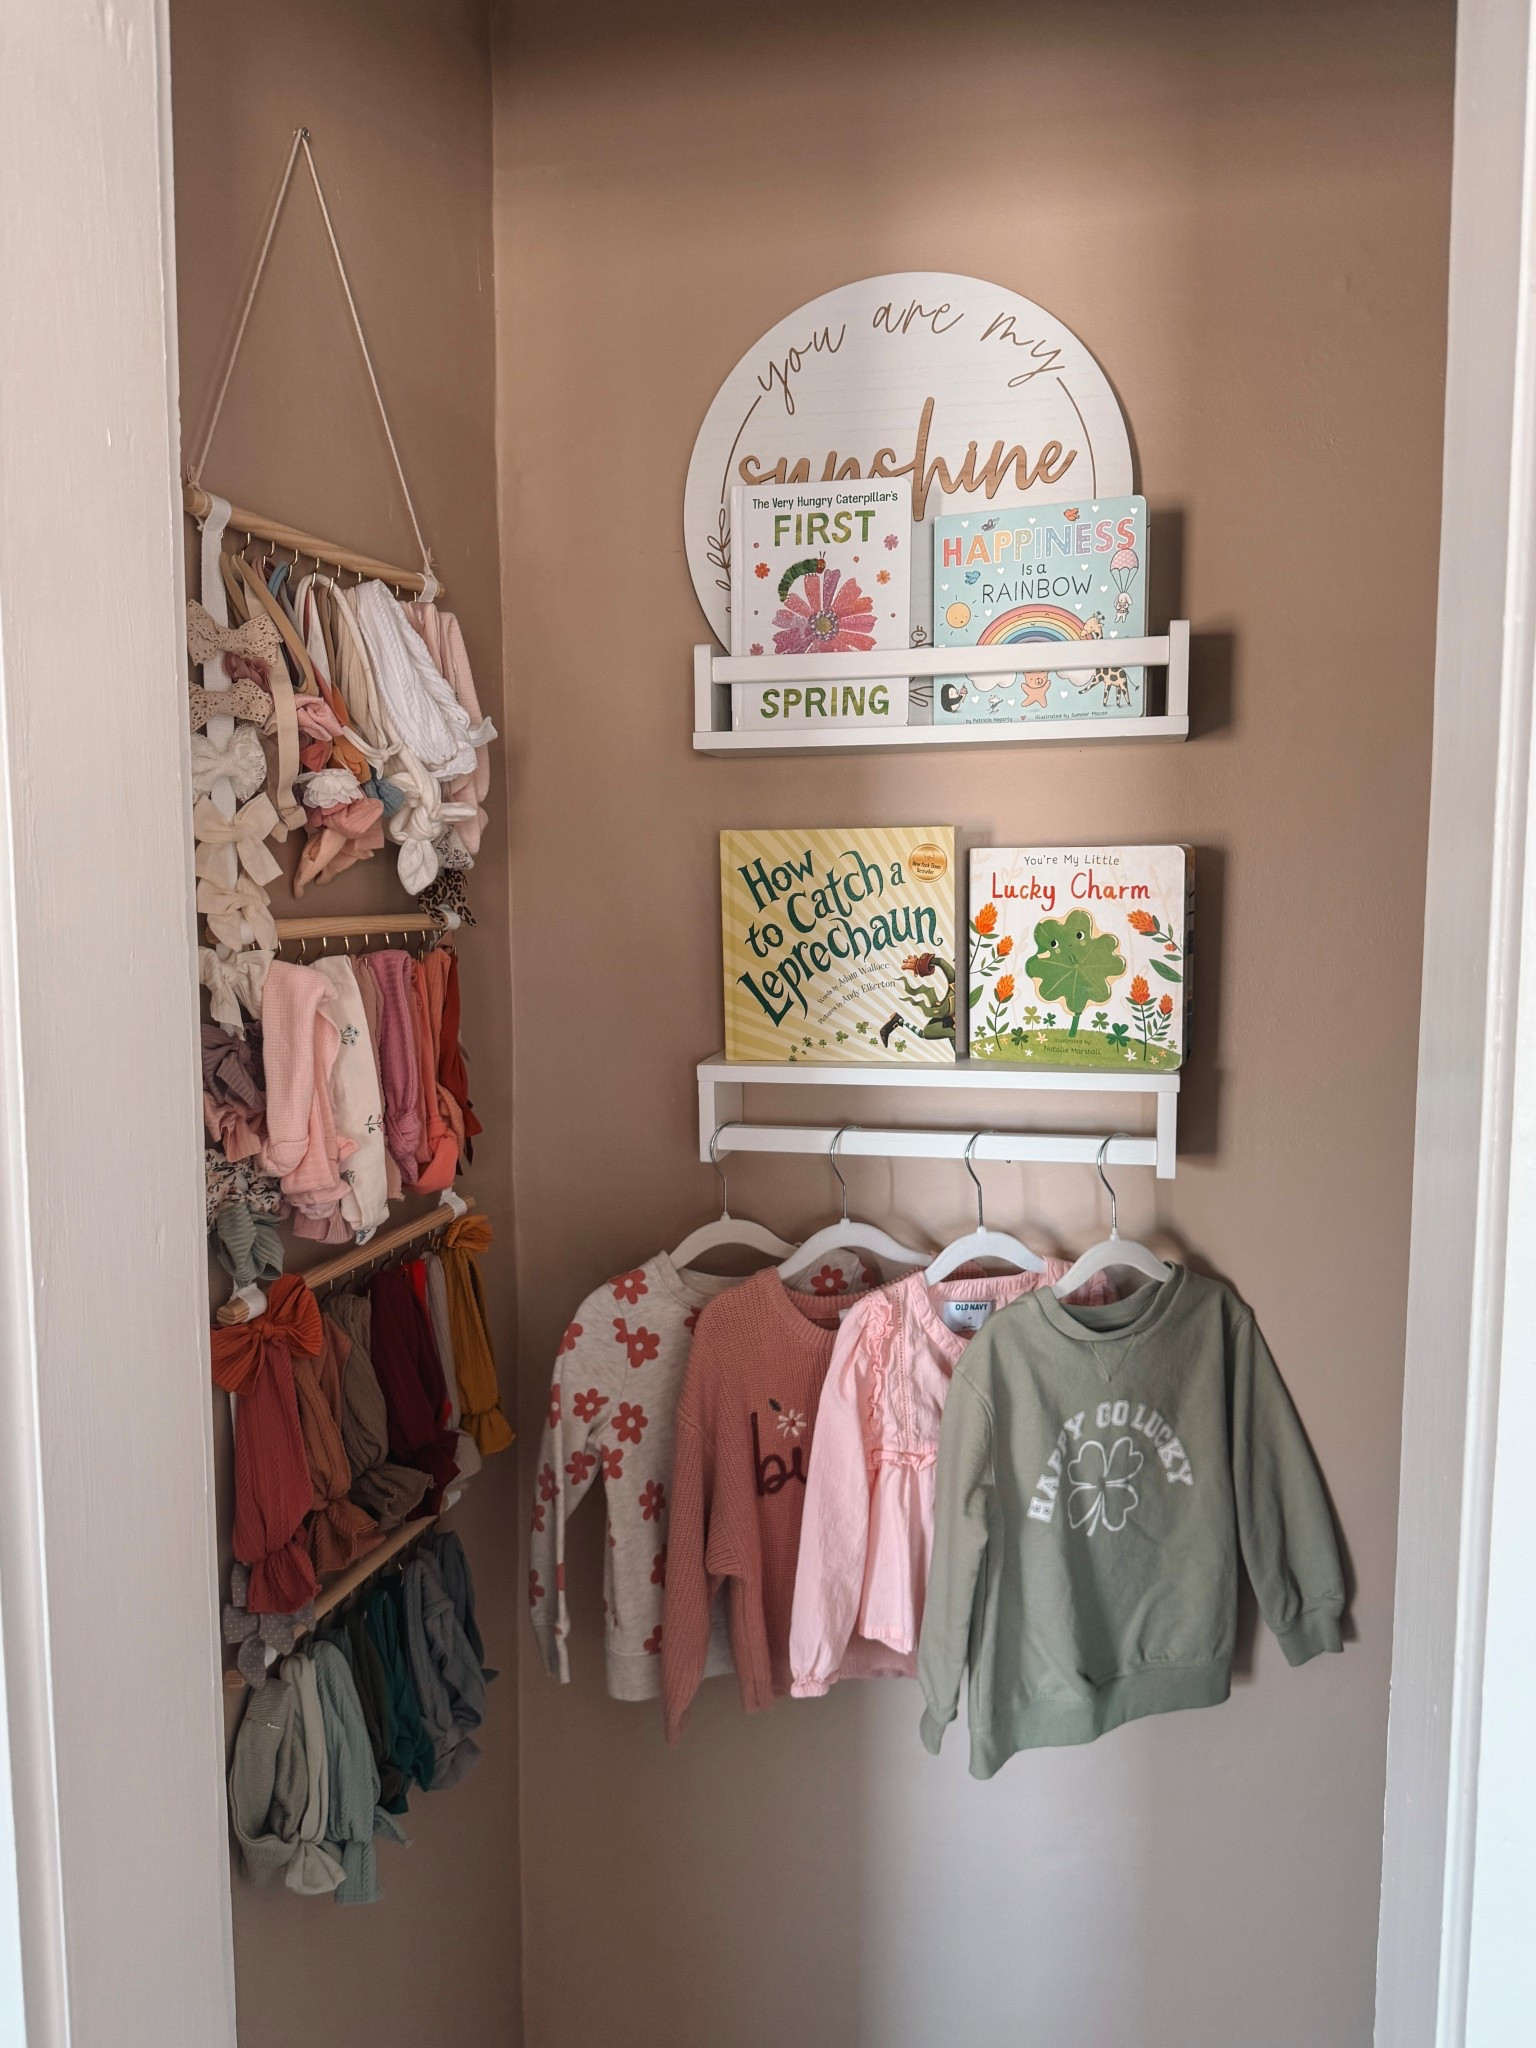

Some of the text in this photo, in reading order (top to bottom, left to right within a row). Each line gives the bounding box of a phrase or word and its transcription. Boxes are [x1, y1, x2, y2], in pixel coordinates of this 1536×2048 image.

[757, 299, 1065, 415] you are my
[753, 491, 898, 511] The Very Hungry Caterpillar's
[774, 510, 876, 547] FIRST
[942, 517, 1136, 568] HAPPINESS
[982, 574, 1092, 604] RAINBOW
[1036, 563, 1047, 574] a
[760, 684, 889, 719] SPRING
[737, 850, 814, 913] How
[1024, 854, 1120, 867] You're My Little
[745, 850, 906, 958] to Catch a
[991, 869, 1151, 912] Lucky Charm
[736, 906, 943, 1027] Leprechaun
[817, 962, 890, 1004] Words by Adam Wallace
[817, 1006, 837, 1025] Pictures
[842, 989, 860, 1004] Andy
[860, 980, 896, 993] Elkerton
[1043, 1045, 1069, 1053] Natalie
[1027, 1400, 1194, 1523] HAPPY GO LUCKY
